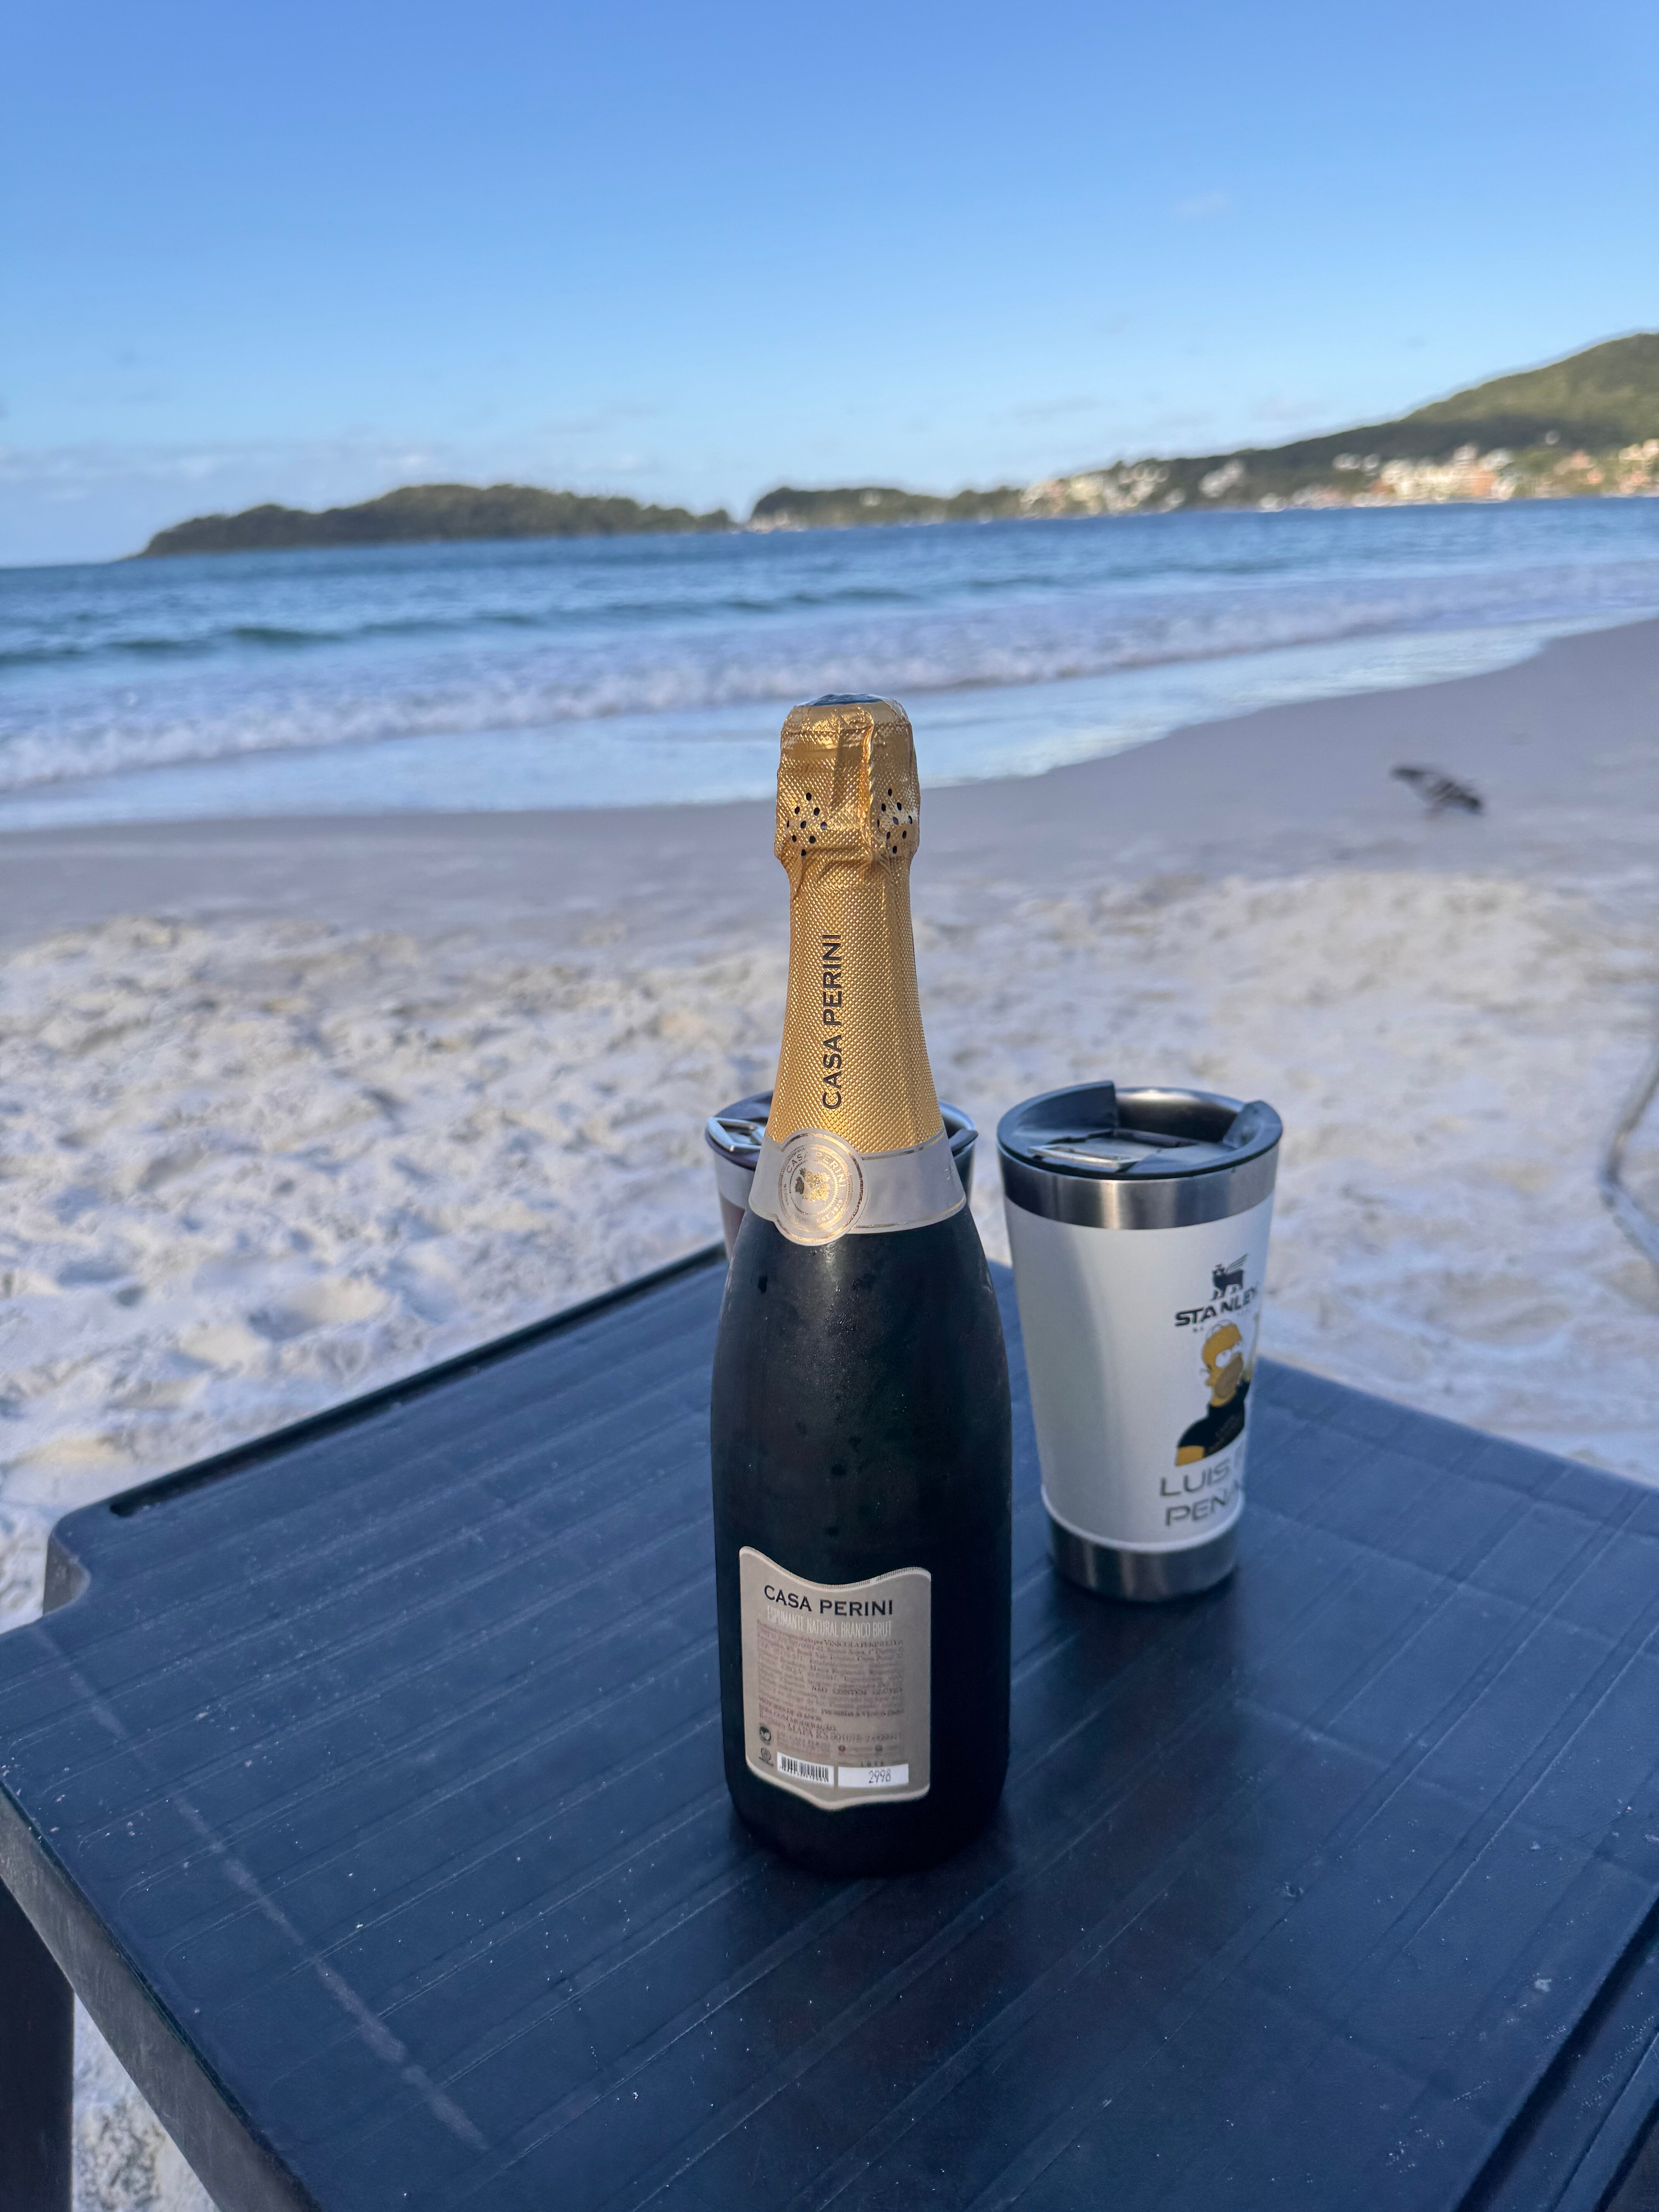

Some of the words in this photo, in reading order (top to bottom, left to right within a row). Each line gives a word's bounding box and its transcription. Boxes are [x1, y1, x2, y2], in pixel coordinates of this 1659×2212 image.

[822, 934, 842, 1026] PERINI
[822, 1035, 842, 1110] CASA
[787, 1151, 811, 1173] CASA
[816, 1152, 846, 1188] PERINI
[1160, 1458, 1230, 1496] LUIS
[764, 1585, 812, 1612] CASA
[819, 1599, 893, 1616] PERINI
[767, 1605, 804, 1632] ESPUMANTE
[807, 1617, 839, 1637] NATURAL
[841, 1621, 871, 1638] BRANCO
[873, 1621, 891, 1638] BRUT
[868, 1768, 891, 1784] 2998
